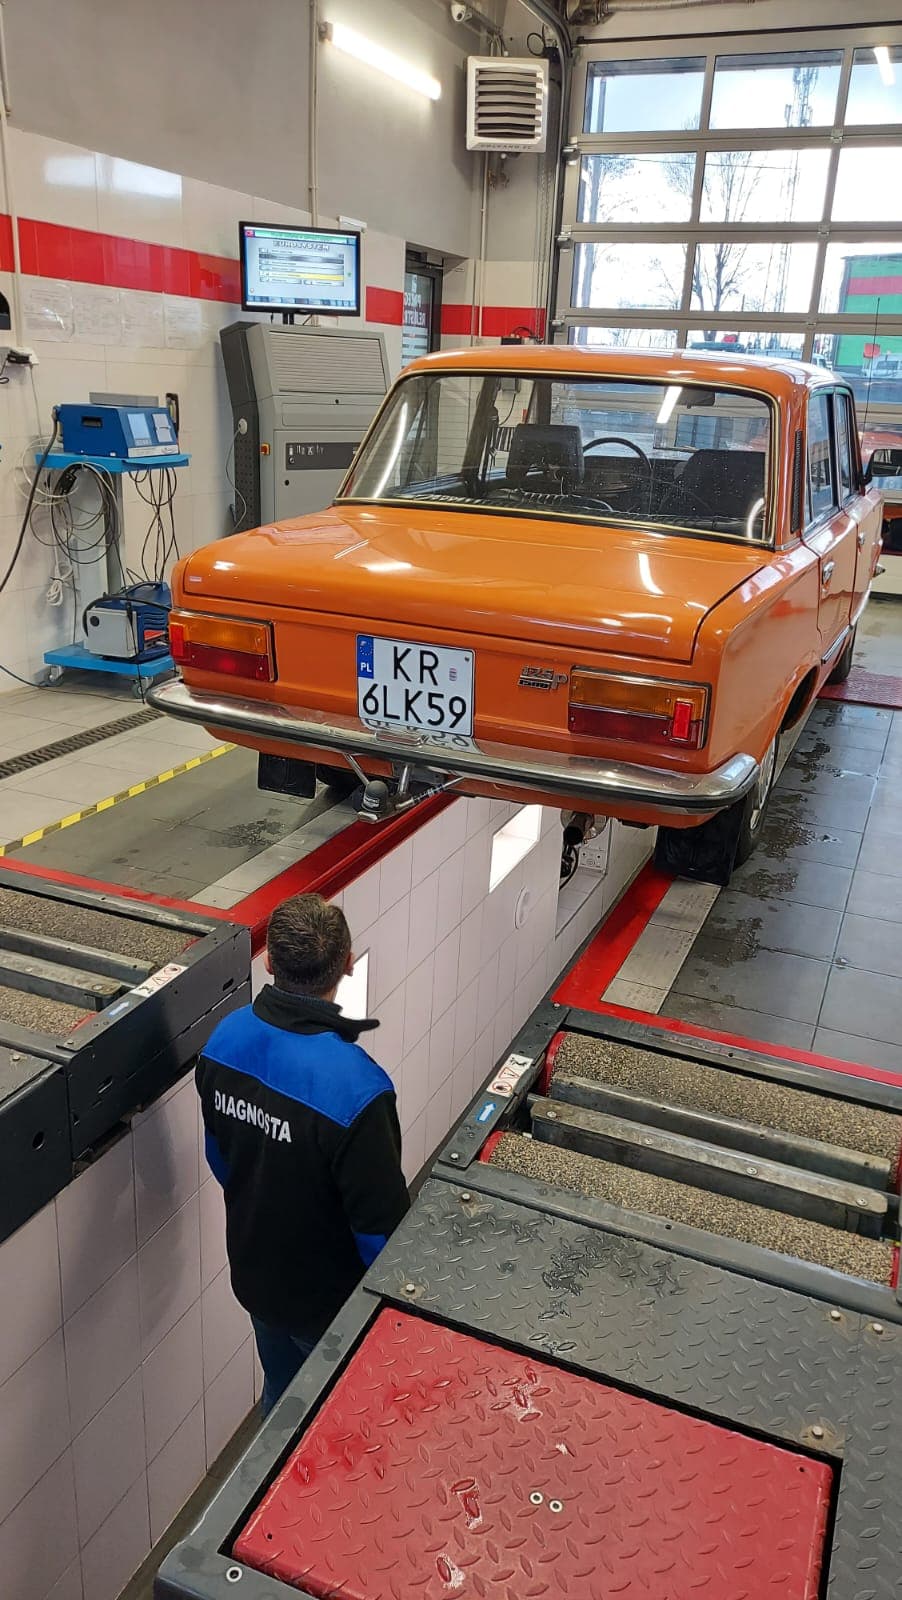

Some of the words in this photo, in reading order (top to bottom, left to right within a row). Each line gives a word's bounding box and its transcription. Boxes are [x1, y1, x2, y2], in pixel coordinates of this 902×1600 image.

[272, 240, 330, 251] EUROSYSTEM
[360, 662, 373, 673] PL
[393, 646, 439, 686] KR
[362, 683, 467, 729] 6LK59
[214, 1089, 292, 1143] DIAGNOSTA
